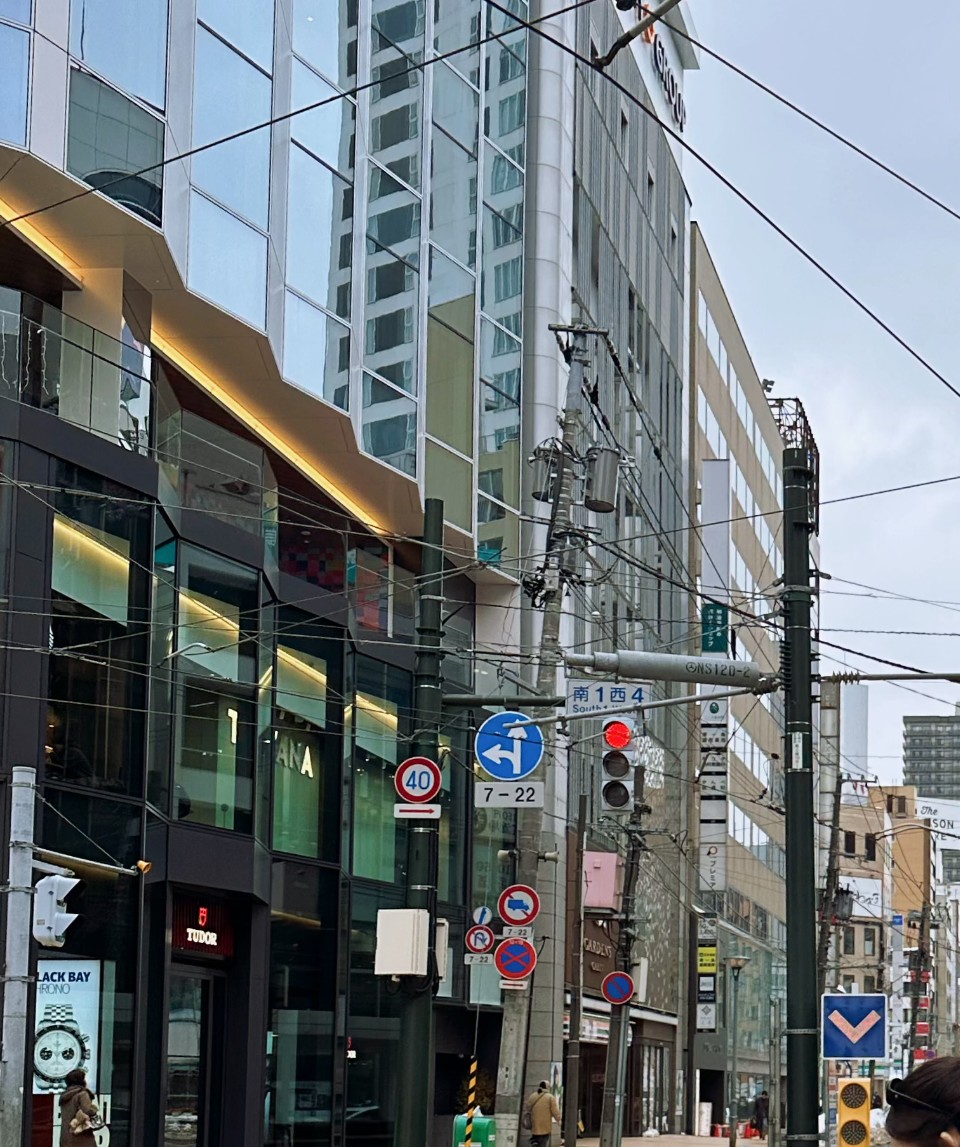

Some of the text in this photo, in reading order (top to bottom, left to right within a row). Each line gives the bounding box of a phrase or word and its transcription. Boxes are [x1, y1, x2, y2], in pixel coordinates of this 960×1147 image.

[573, 686, 645, 703] 南1西4
[405, 770, 431, 790] 40
[920, 805, 939, 816] The
[186, 928, 218, 946] TUDOR
[68, 971, 91, 983] BAY
